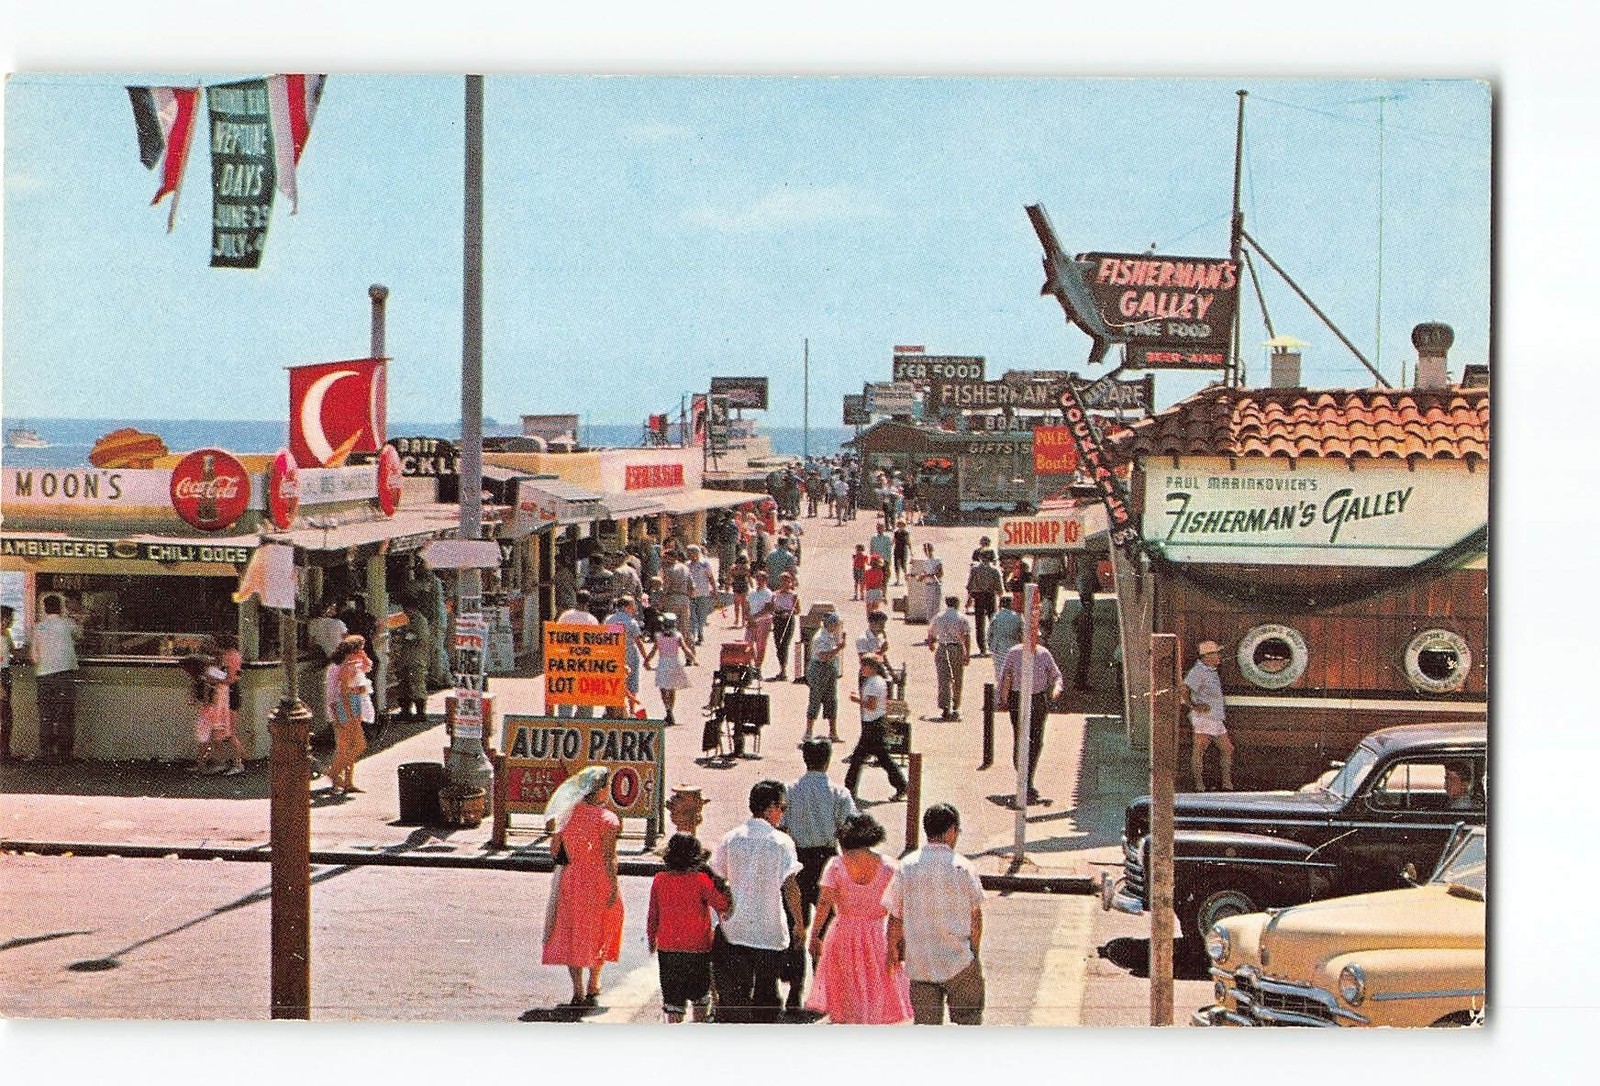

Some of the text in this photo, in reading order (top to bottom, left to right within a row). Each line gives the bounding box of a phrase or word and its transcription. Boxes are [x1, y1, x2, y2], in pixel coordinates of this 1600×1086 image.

[220, 163, 264, 197] DAYS
[1099, 258, 1236, 289] FISHERMAN'S
[1120, 290, 1214, 319] GALLEY
[1167, 323, 1212, 338] FOOD
[895, 363, 927, 378] SEA
[398, 438, 440, 454] BAIT
[968, 442, 1014, 455] GIFTS
[1061, 391, 1128, 523] COCKTAILS
[15, 471, 123, 500] MOON'S
[176, 475, 240, 499] Coca-Cola
[1165, 476, 1200, 489] PAUL
[1166, 487, 1413, 543] FISHERMAN'S GALLEY
[1003, 521, 1060, 545] SHRIMP
[4, 540, 109, 559] AMBURGERS
[200, 546, 248, 563] DOGS
[549, 631, 620, 646] TURN RIGHT
[569, 646, 591, 656] FOR
[548, 658, 619, 673] PARKING
[548, 677, 621, 696] LOT ONLY
[508, 726, 657, 763] AUTO PARK
[520, 770, 556, 785] ALL
